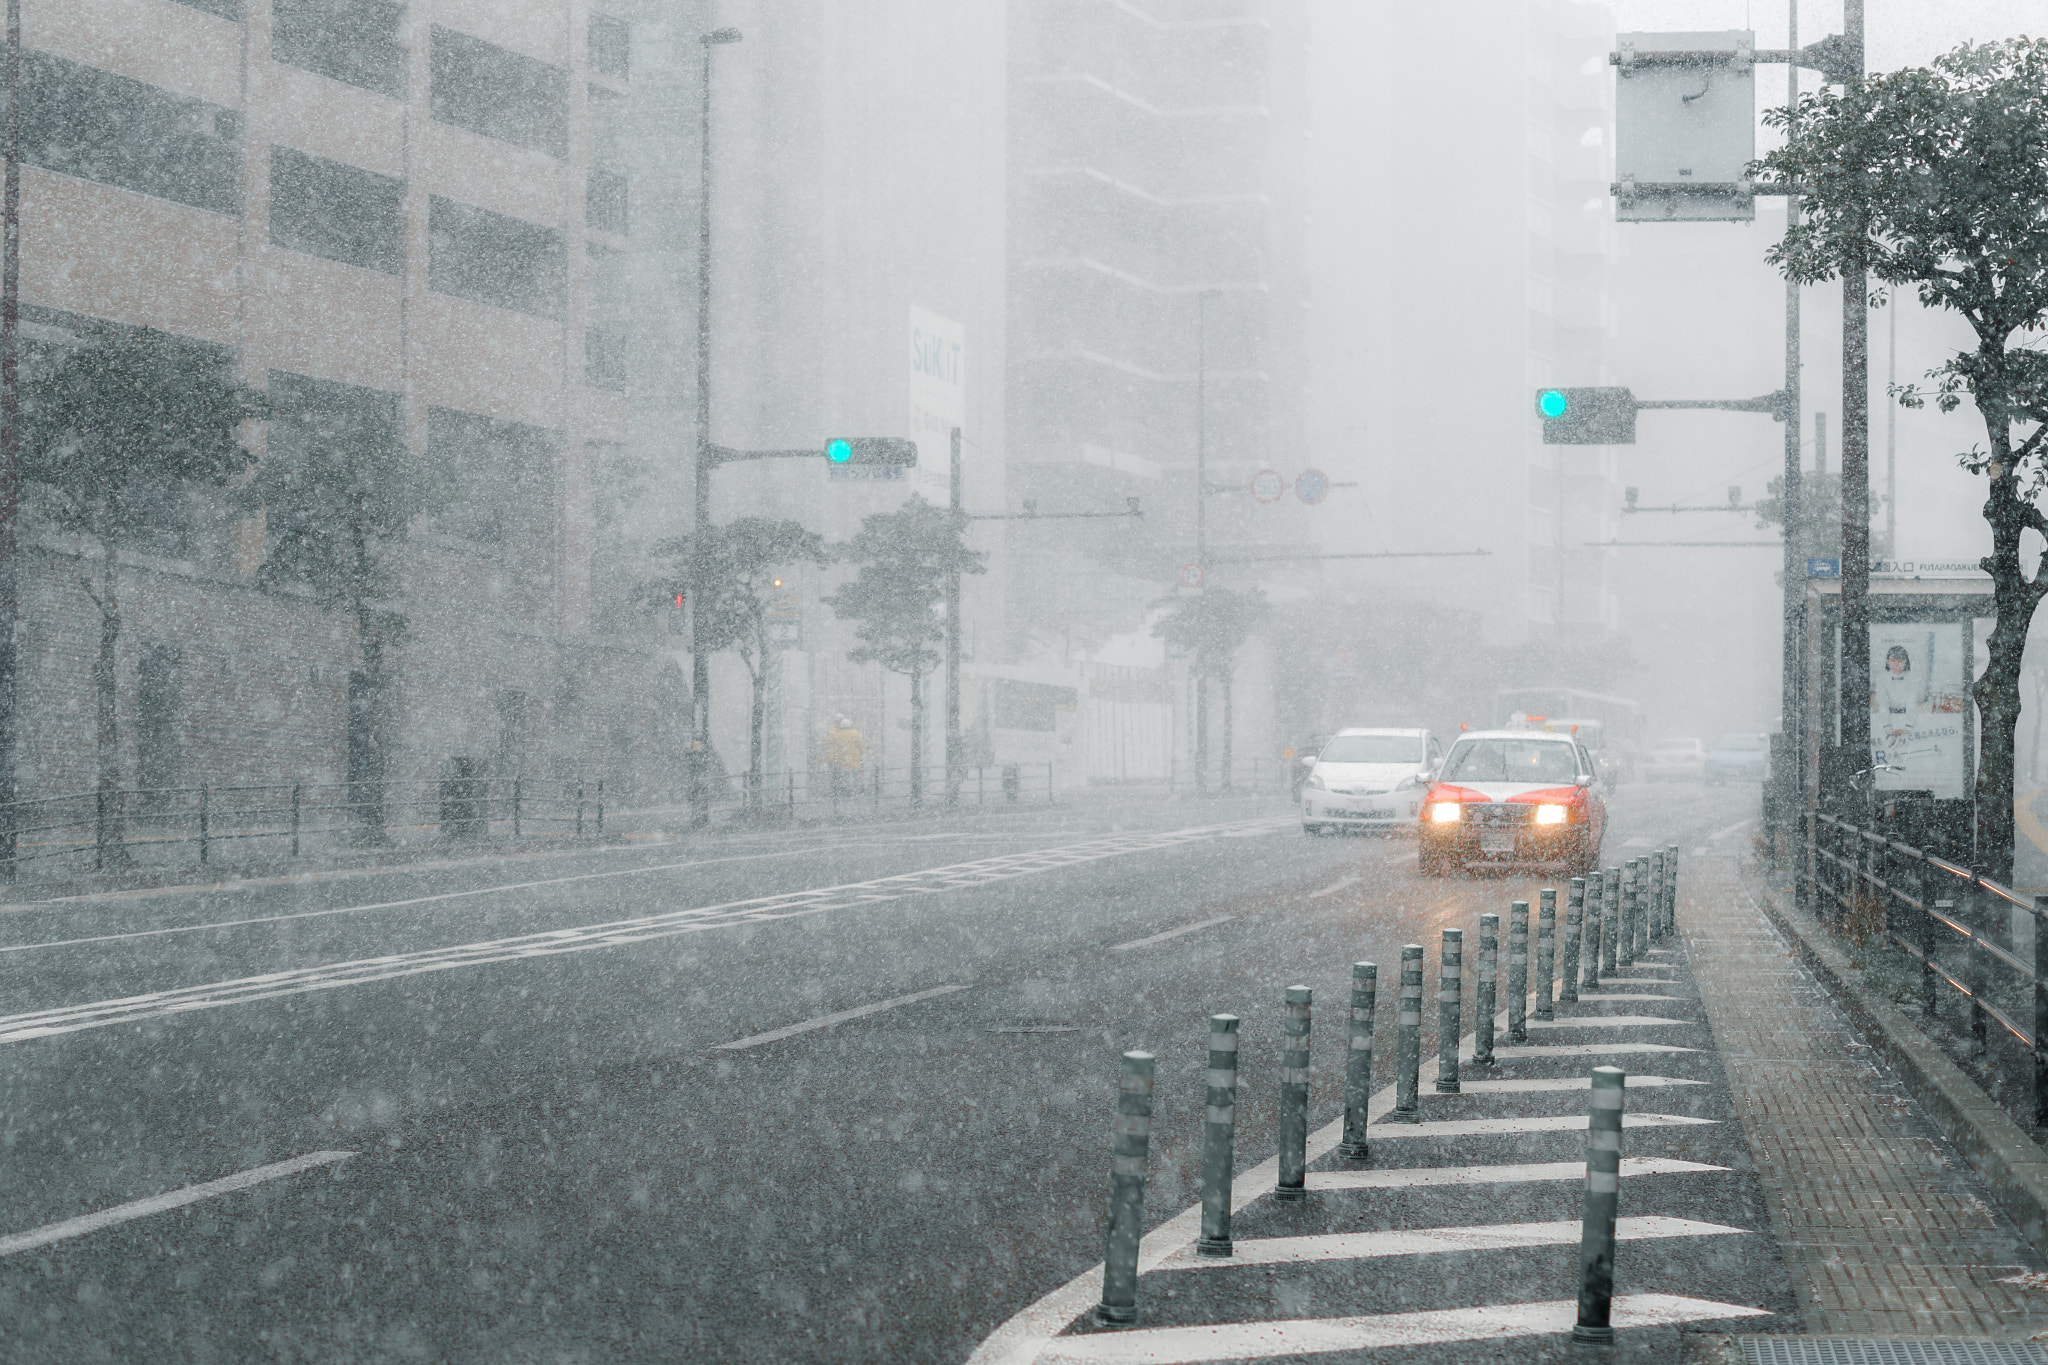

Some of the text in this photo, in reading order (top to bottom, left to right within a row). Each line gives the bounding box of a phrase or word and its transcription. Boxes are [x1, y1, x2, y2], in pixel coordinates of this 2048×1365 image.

[1874, 561, 1914, 573] 園入口
[1919, 563, 1981, 571] FUTABAGAKUE
